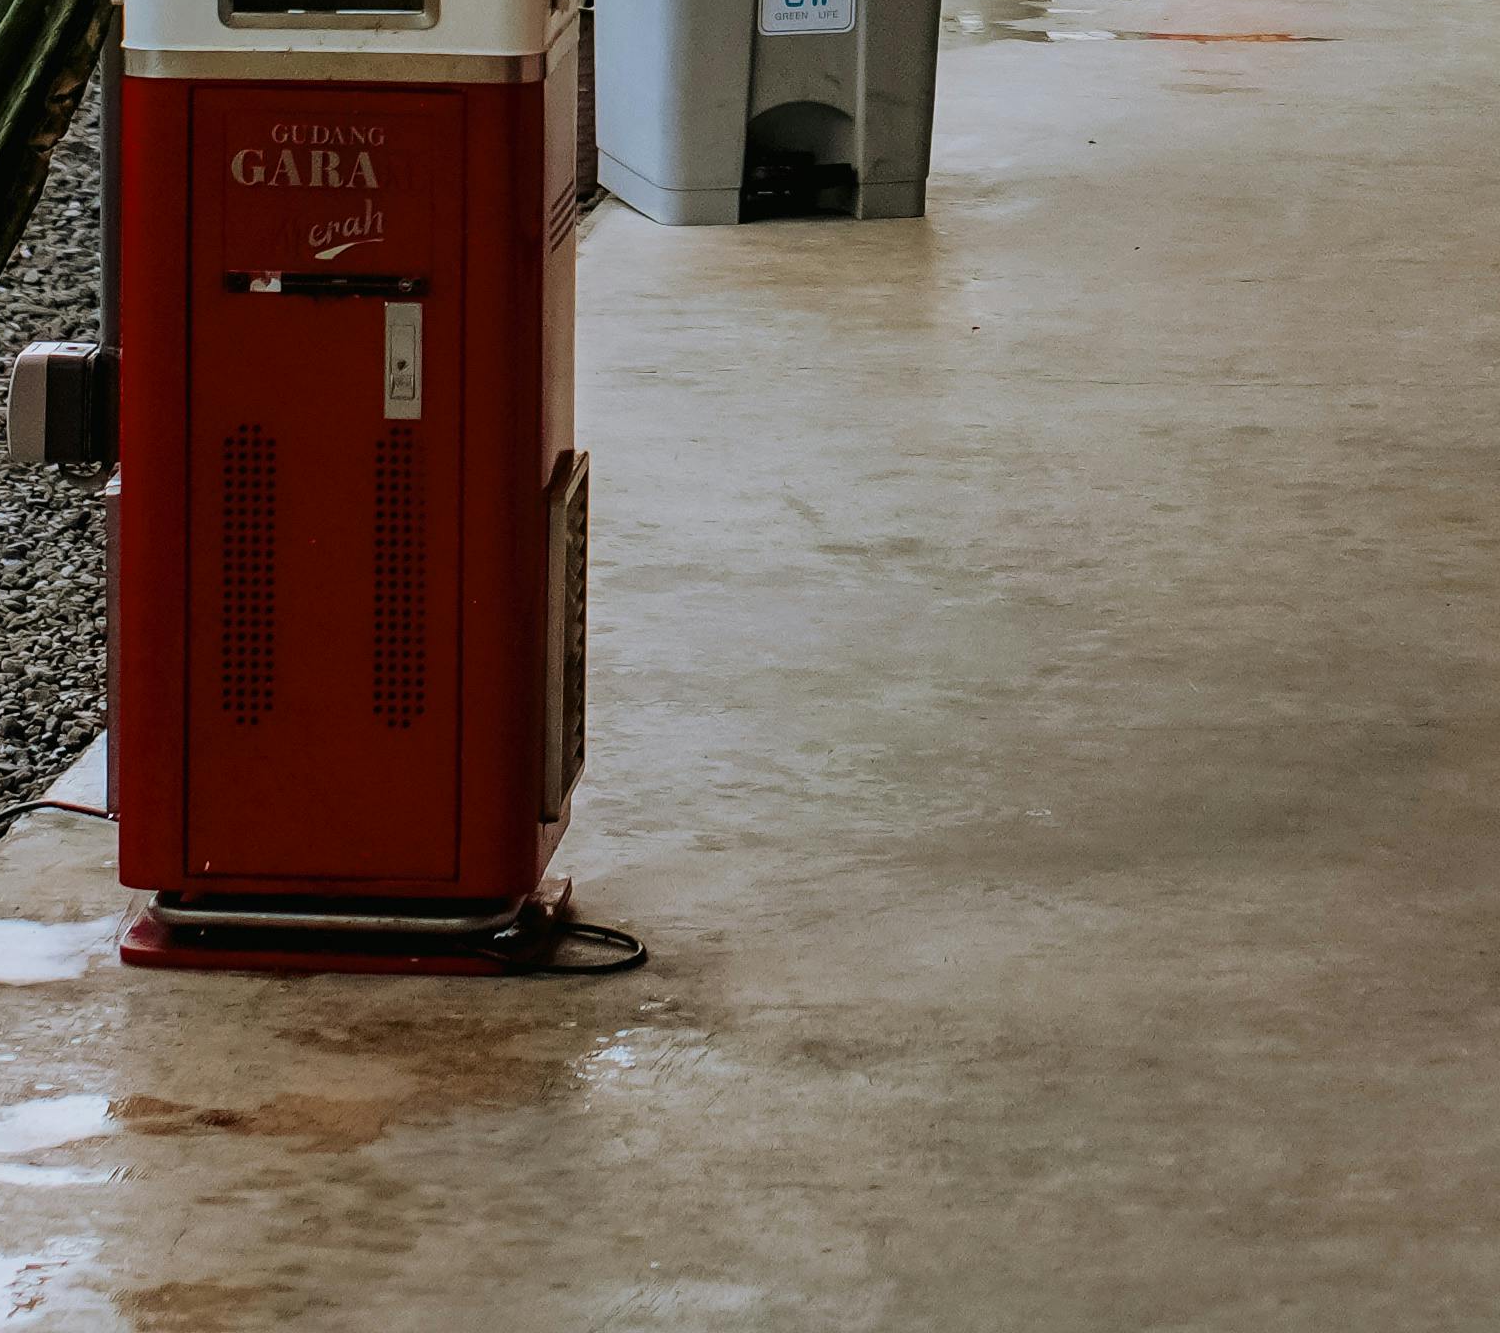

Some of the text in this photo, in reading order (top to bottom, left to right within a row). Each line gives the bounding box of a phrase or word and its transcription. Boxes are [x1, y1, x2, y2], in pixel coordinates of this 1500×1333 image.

[774, 9, 839, 21] GREEN LIFE
[271, 123, 386, 147] GUDANG
